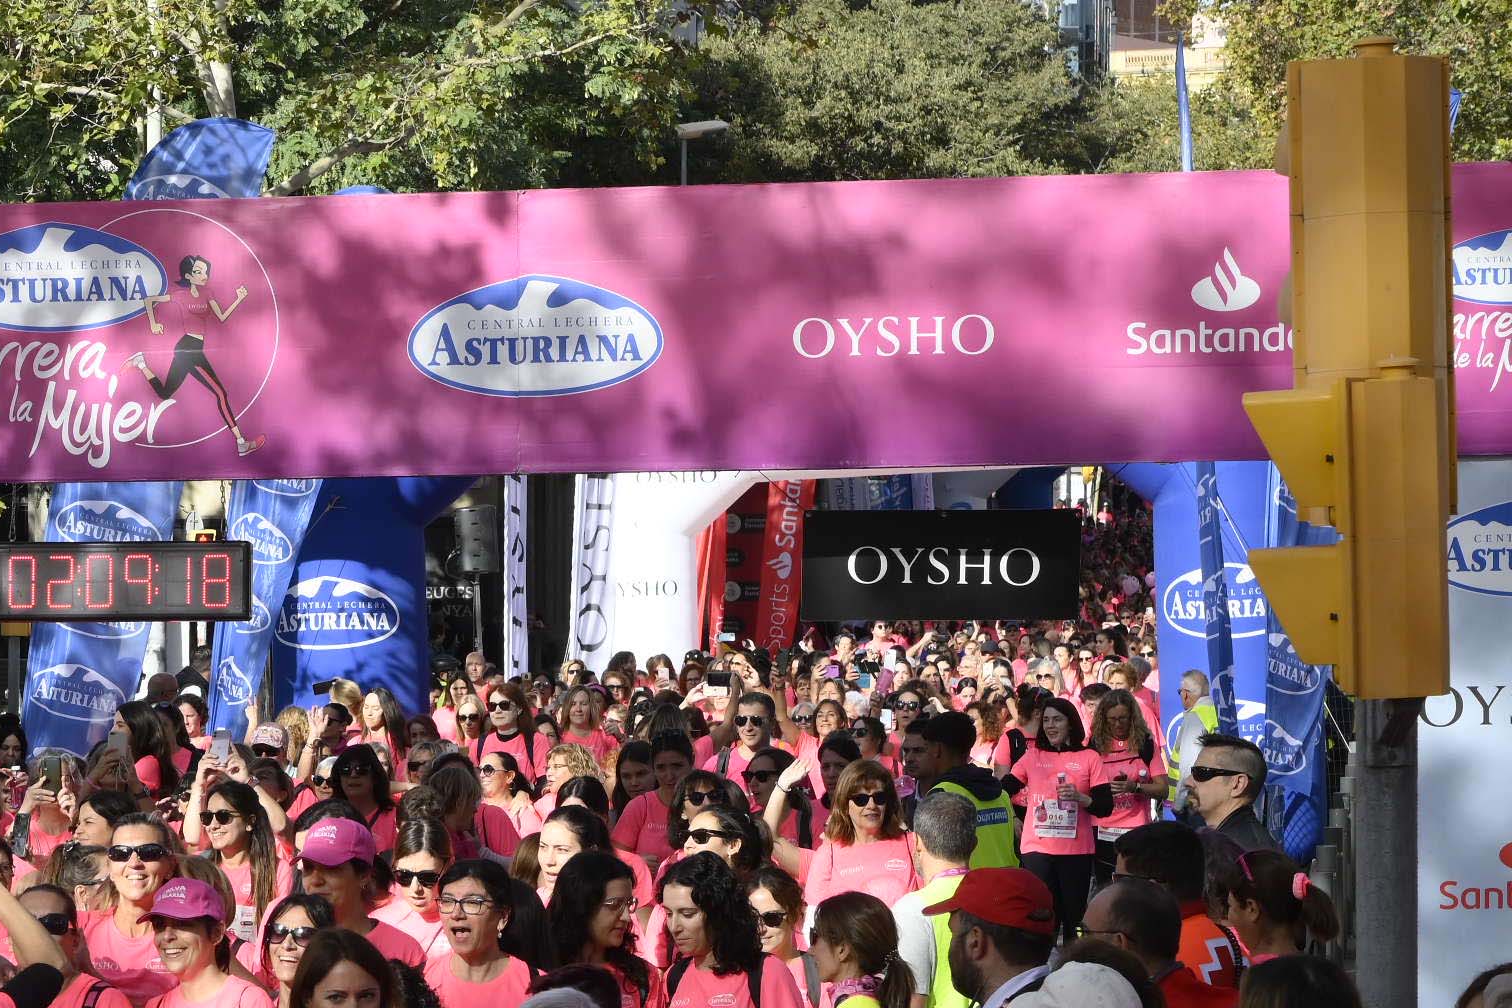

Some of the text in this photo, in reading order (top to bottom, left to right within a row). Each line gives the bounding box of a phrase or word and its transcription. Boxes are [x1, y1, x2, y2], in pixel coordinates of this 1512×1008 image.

[71, 258, 142, 270] LECHERA
[1453, 259, 1512, 286] ASTU
[1467, 255, 1512, 263] CENTRA
[467, 316, 634, 330] CENTRAL LECHERA
[791, 314, 995, 360] OYSHO
[1454, 311, 1512, 340] arre
[427, 323, 644, 366] ASTURIANA
[1476, 341, 1495, 369] la
[8, 384, 33, 423] la
[29, 375, 177, 469] Mujer
[846, 545, 1042, 588] OYSHO
[8, 554, 231, 610] 02:09:18
[616, 579, 680, 598] YSHO
[290, 600, 387, 610] CENTRAL LECHERA
[278, 606, 391, 634] ASTURIANA
[35, 676, 117, 711] ASTURIANA
